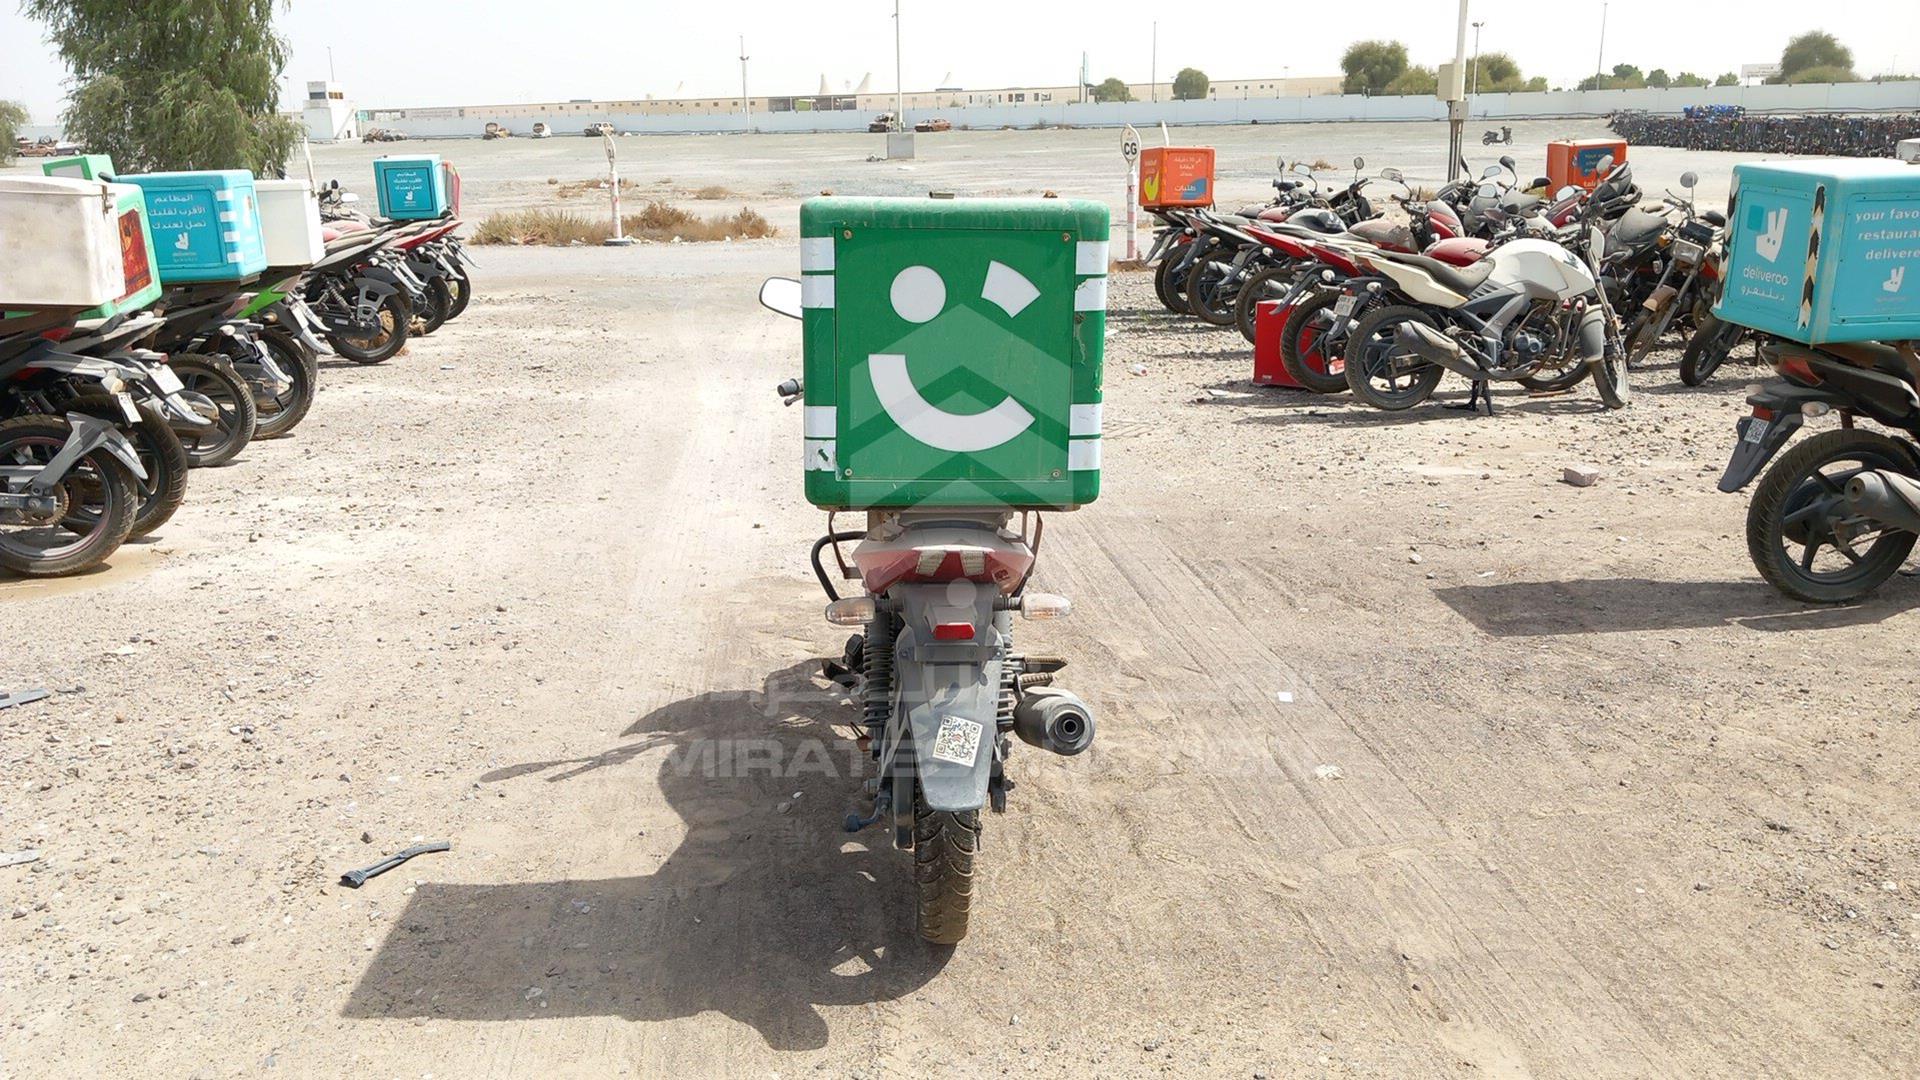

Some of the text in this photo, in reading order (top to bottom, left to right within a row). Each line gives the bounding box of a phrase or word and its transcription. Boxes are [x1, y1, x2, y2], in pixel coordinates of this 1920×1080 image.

[1123, 142, 1138, 156] CG
[154, 194, 193, 204] المطاعم
[1855, 211, 1885, 224] your
[1743, 264, 1789, 286] deliveroo
